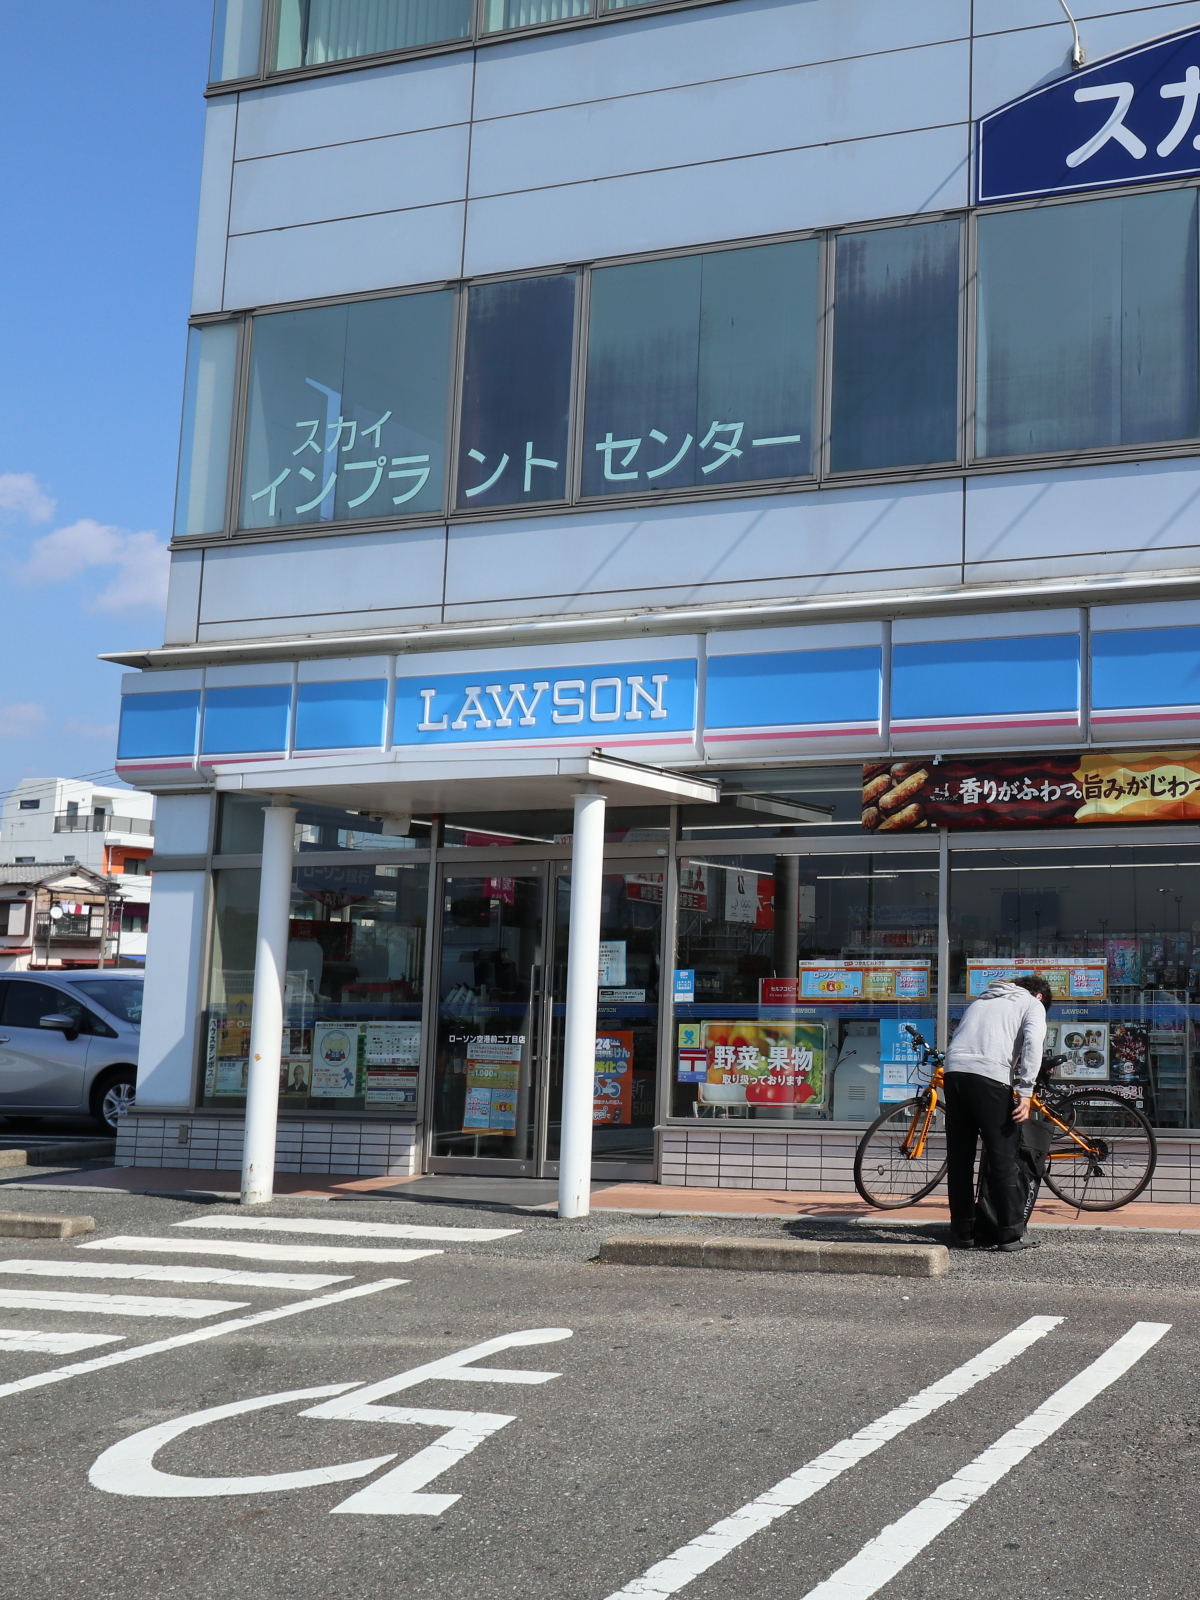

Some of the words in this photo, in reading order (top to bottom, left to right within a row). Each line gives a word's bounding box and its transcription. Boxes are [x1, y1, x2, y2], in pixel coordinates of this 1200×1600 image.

[293, 411, 392, 456] スカイ
[417, 674, 668, 732] LAWSON
[207, 1020, 217, 1077] ハウステンボス
[449, 1035, 526, 1044] ローソン空港前二丁目店
[714, 1045, 813, 1071] 野菜・果物
[722, 1074, 804, 1086] 取り扱っております
[1024, 1190, 1034, 1220] Colum
